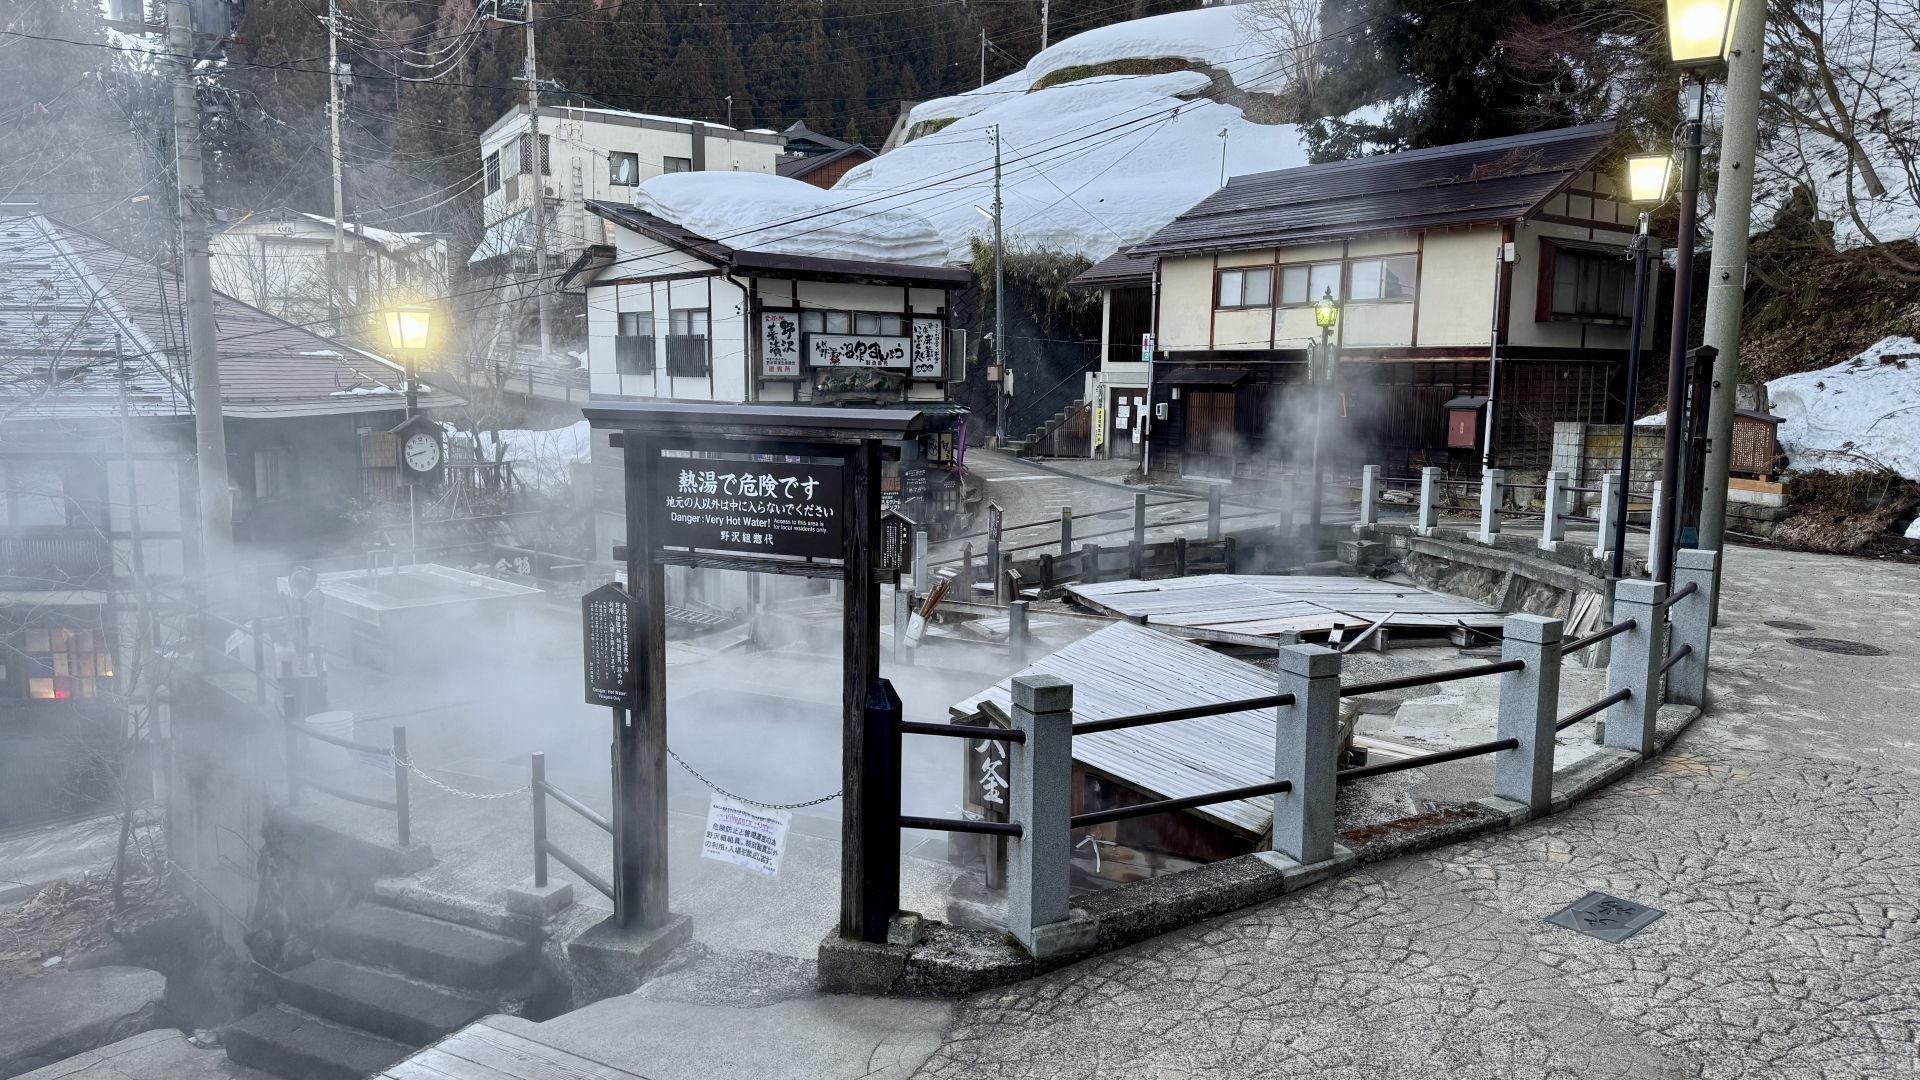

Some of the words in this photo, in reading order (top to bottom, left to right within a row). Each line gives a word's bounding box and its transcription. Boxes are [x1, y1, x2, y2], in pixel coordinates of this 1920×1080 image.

[767, 322, 782, 357] 菜漬
[780, 320, 796, 353] 野沢
[678, 469, 820, 501] 熱湯で危険です
[666, 496, 834, 517] 地元の人以外は中に入らないでください
[726, 516, 741, 526] Hot
[743, 517, 770, 528] Water!
[720, 530, 774, 546] 野沢組惣代
[712, 822, 776, 846] 危険防止と管理運営の為
